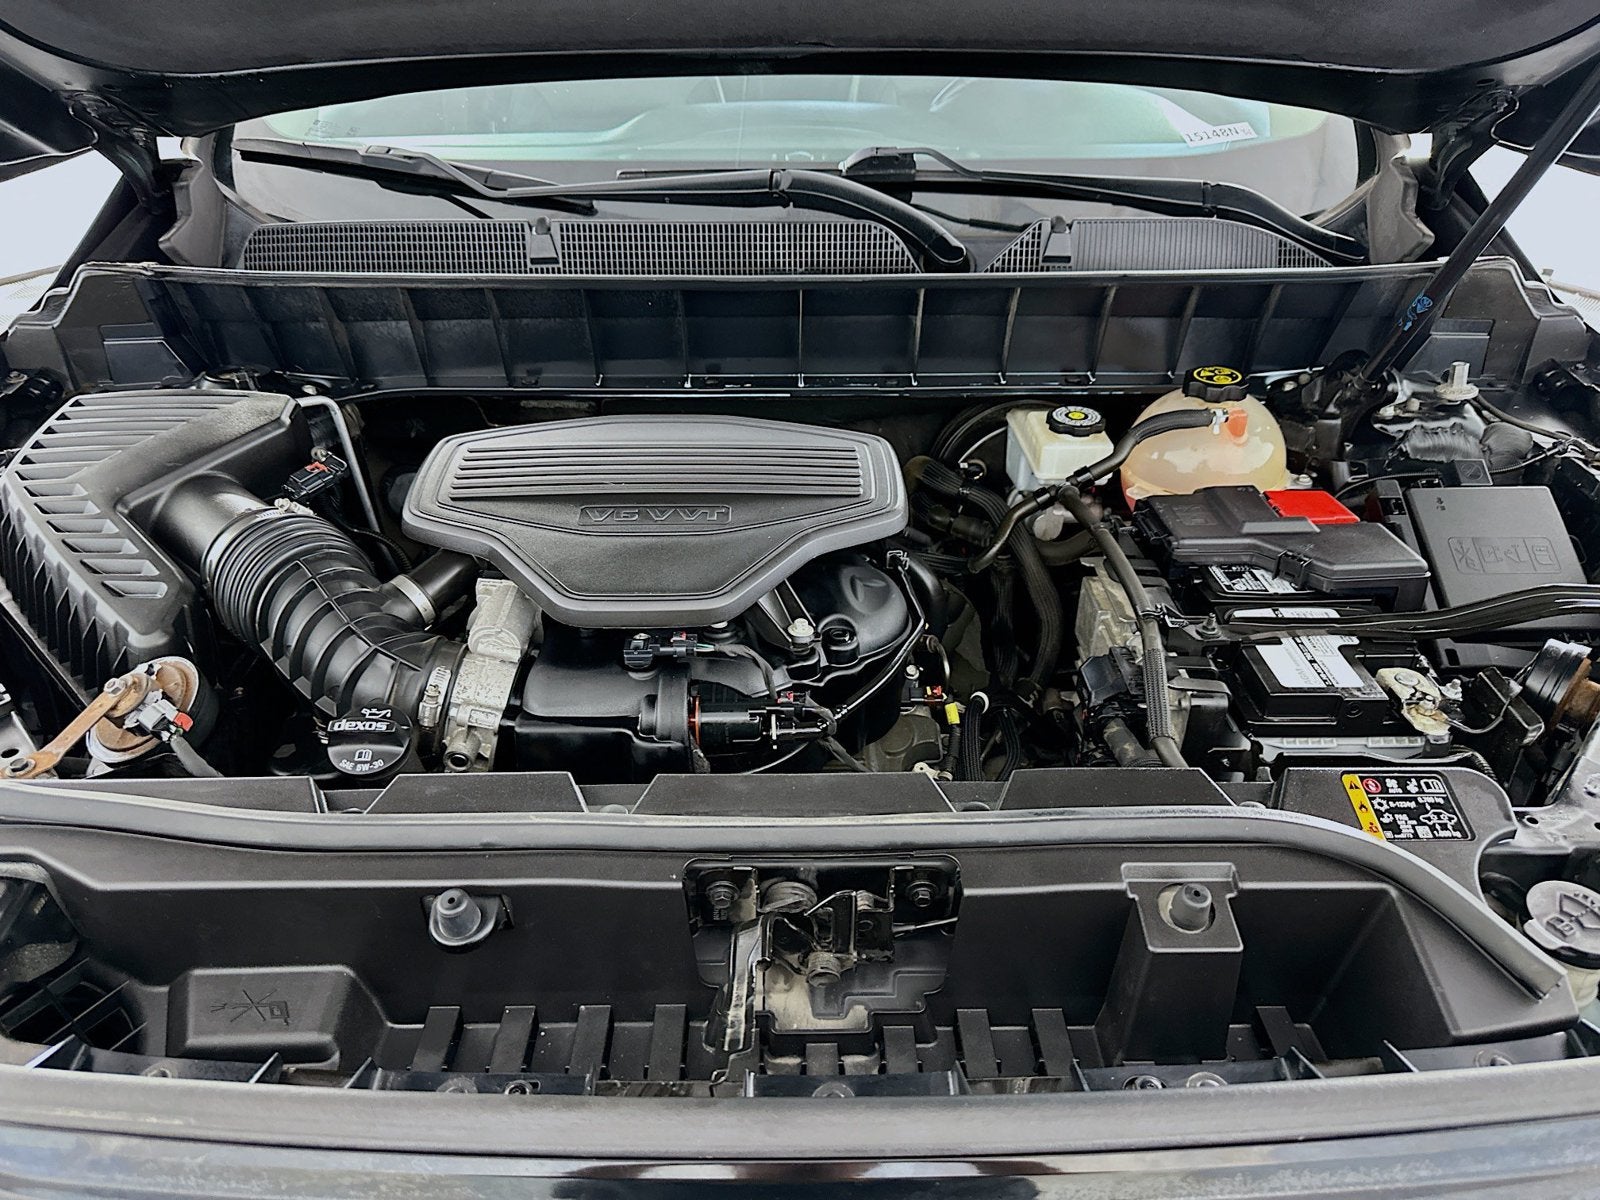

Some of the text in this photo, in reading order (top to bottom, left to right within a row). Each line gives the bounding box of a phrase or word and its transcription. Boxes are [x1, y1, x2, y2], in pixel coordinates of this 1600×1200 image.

[585, 508, 726, 521] V6 VVT
[333, 719, 391, 731] dexos
[339, 759, 355, 771] SAE
